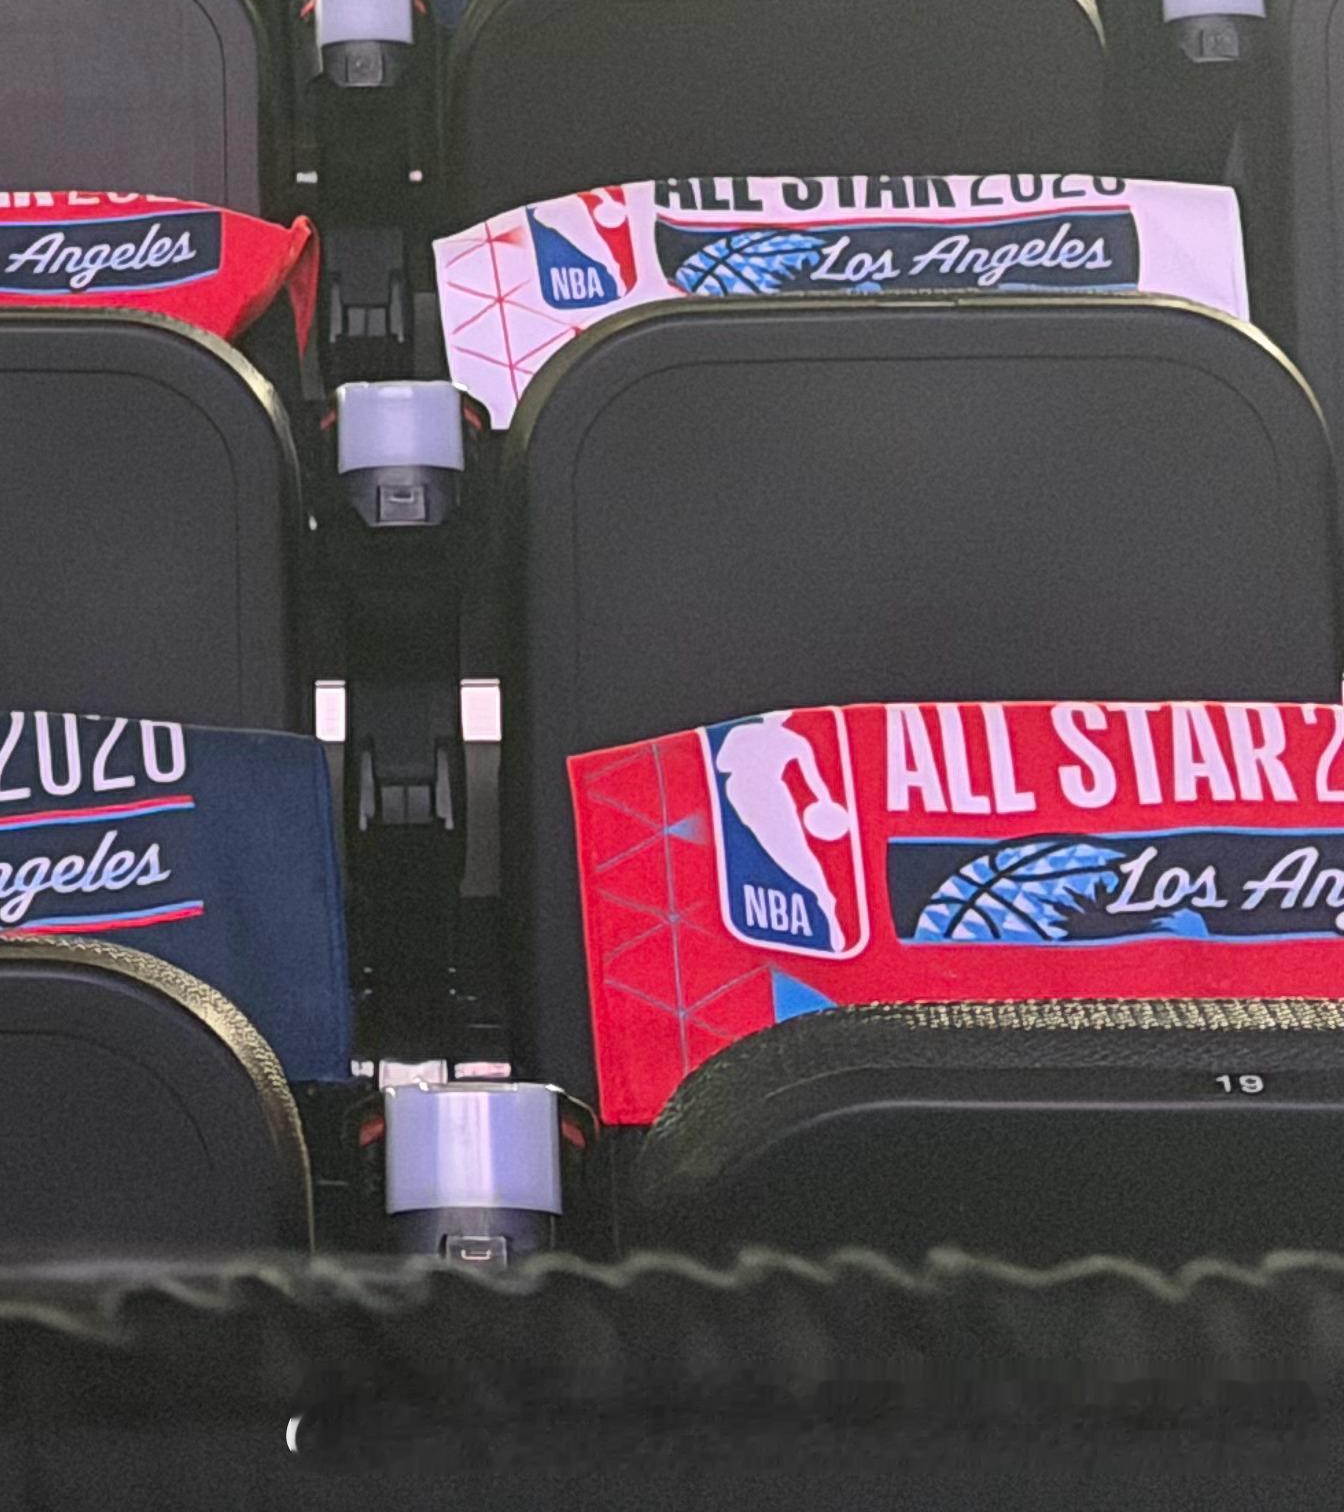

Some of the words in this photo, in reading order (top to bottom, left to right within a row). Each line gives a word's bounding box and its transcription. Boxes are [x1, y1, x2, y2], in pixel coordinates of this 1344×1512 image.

[6, 221, 197, 289] Angeles
[809, 234, 901, 282] Los
[906, 222, 1113, 282] Angeles
[549, 264, 606, 303] NBA
[886, 703, 1036, 816] ALL
[1049, 701, 1307, 808] STAR
[743, 883, 812, 938] NBA
[1103, 845, 1227, 916] Los
[1215, 1074, 1264, 1094] 19
